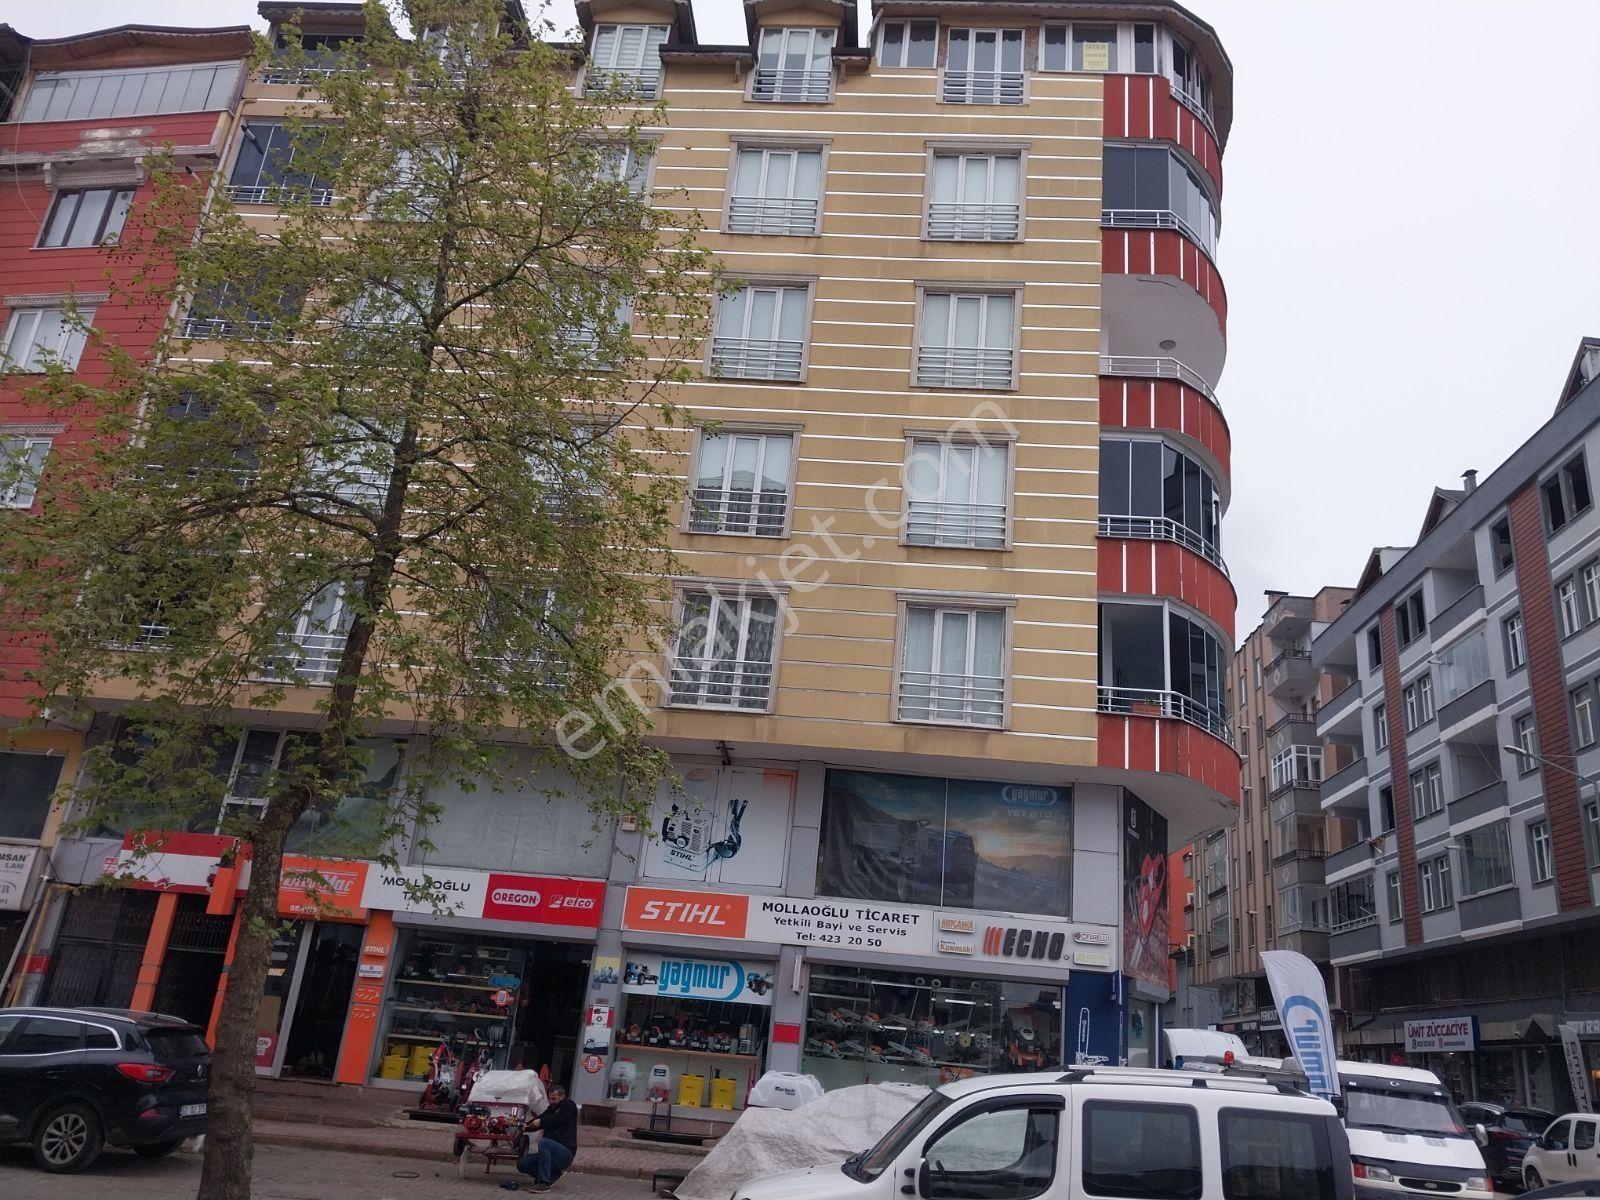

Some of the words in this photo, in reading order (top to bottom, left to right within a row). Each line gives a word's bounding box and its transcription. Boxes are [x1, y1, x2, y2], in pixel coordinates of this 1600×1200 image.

[670, 849, 693, 861] STIHL
[383, 876, 471, 892] MOLOĞLU
[493, 891, 537, 905] OREGON
[565, 897, 594, 909] efco
[640, 900, 727, 926] STIHL
[761, 901, 849, 919] MOLLAOĞLU
[856, 907, 920, 925] TİCARET
[773, 917, 812, 929] Yetkili
[816, 920, 843, 932] Bayi
[848, 924, 862, 932] ve
[867, 924, 907, 936] Servis
[795, 931, 816, 943] Tel:
[819, 933, 841, 944] 423
[848, 935, 862, 946] 20
[867, 936, 882, 947] 50
[939, 943, 974, 953] Kawasaki
[1002, 927, 1066, 961] ECHO
[364, 945, 385, 954] STIHL
[658, 959, 731, 993] yağmur
